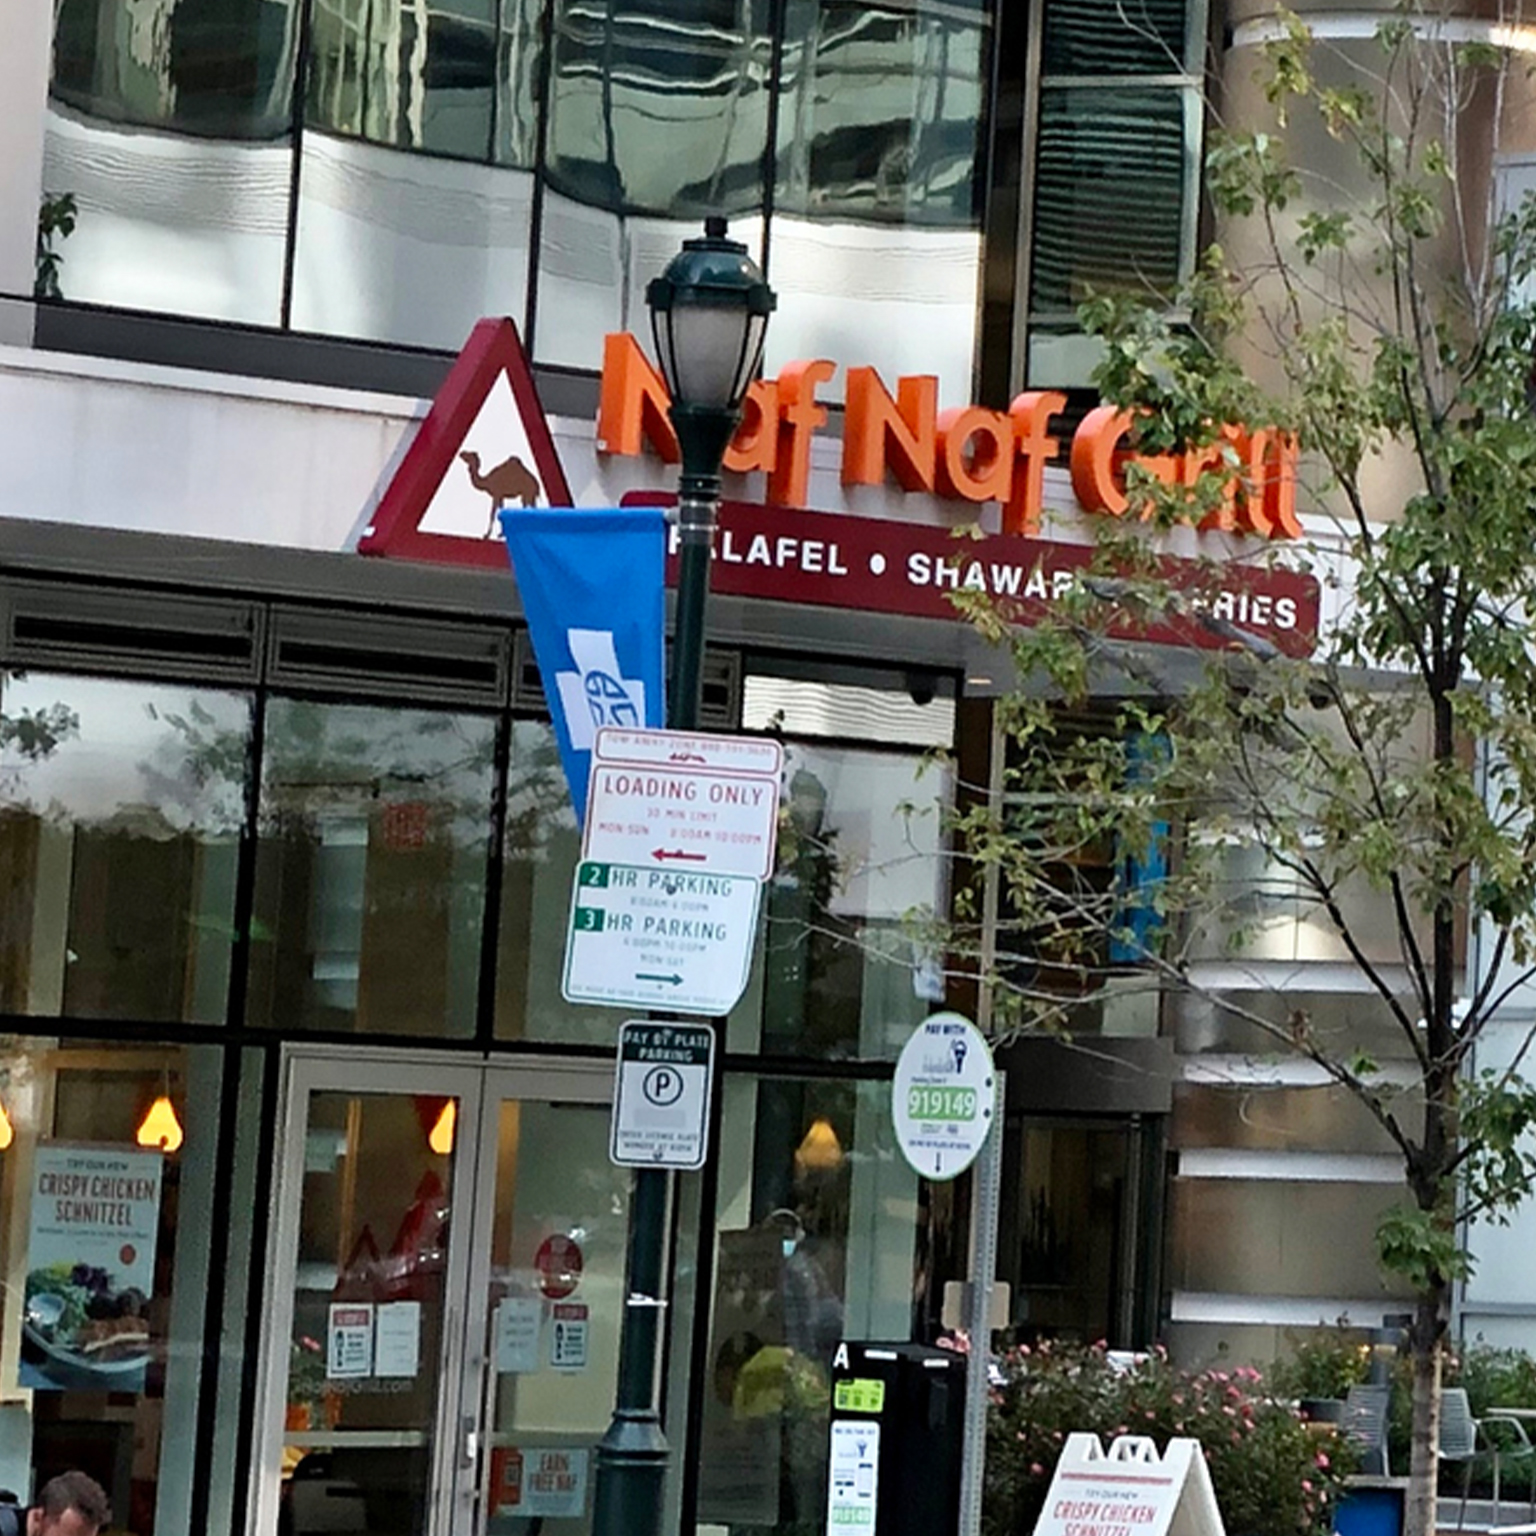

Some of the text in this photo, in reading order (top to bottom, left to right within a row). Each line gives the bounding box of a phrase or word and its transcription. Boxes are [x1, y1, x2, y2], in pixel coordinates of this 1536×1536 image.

[841, 365, 1068, 539] Naf
[668, 525, 848, 576] FLAFEL
[604, 775, 764, 806] LOADING ONLY
[588, 867, 733, 898] 2 HR PARKING
[584, 911, 728, 942] 3 HR PARKING
[623, 1031, 650, 1044] PAY
[674, 1034, 710, 1048] PLATE
[638, 1048, 694, 1062] PARKING
[655, 1072, 671, 1098] P
[909, 1089, 976, 1118] 919149
[39, 1172, 157, 1202] CRISPY CHICKEN
[55, 1200, 132, 1226] SCHNITZEL
[1053, 1500, 1159, 1524] CRISPY CHICKEN
